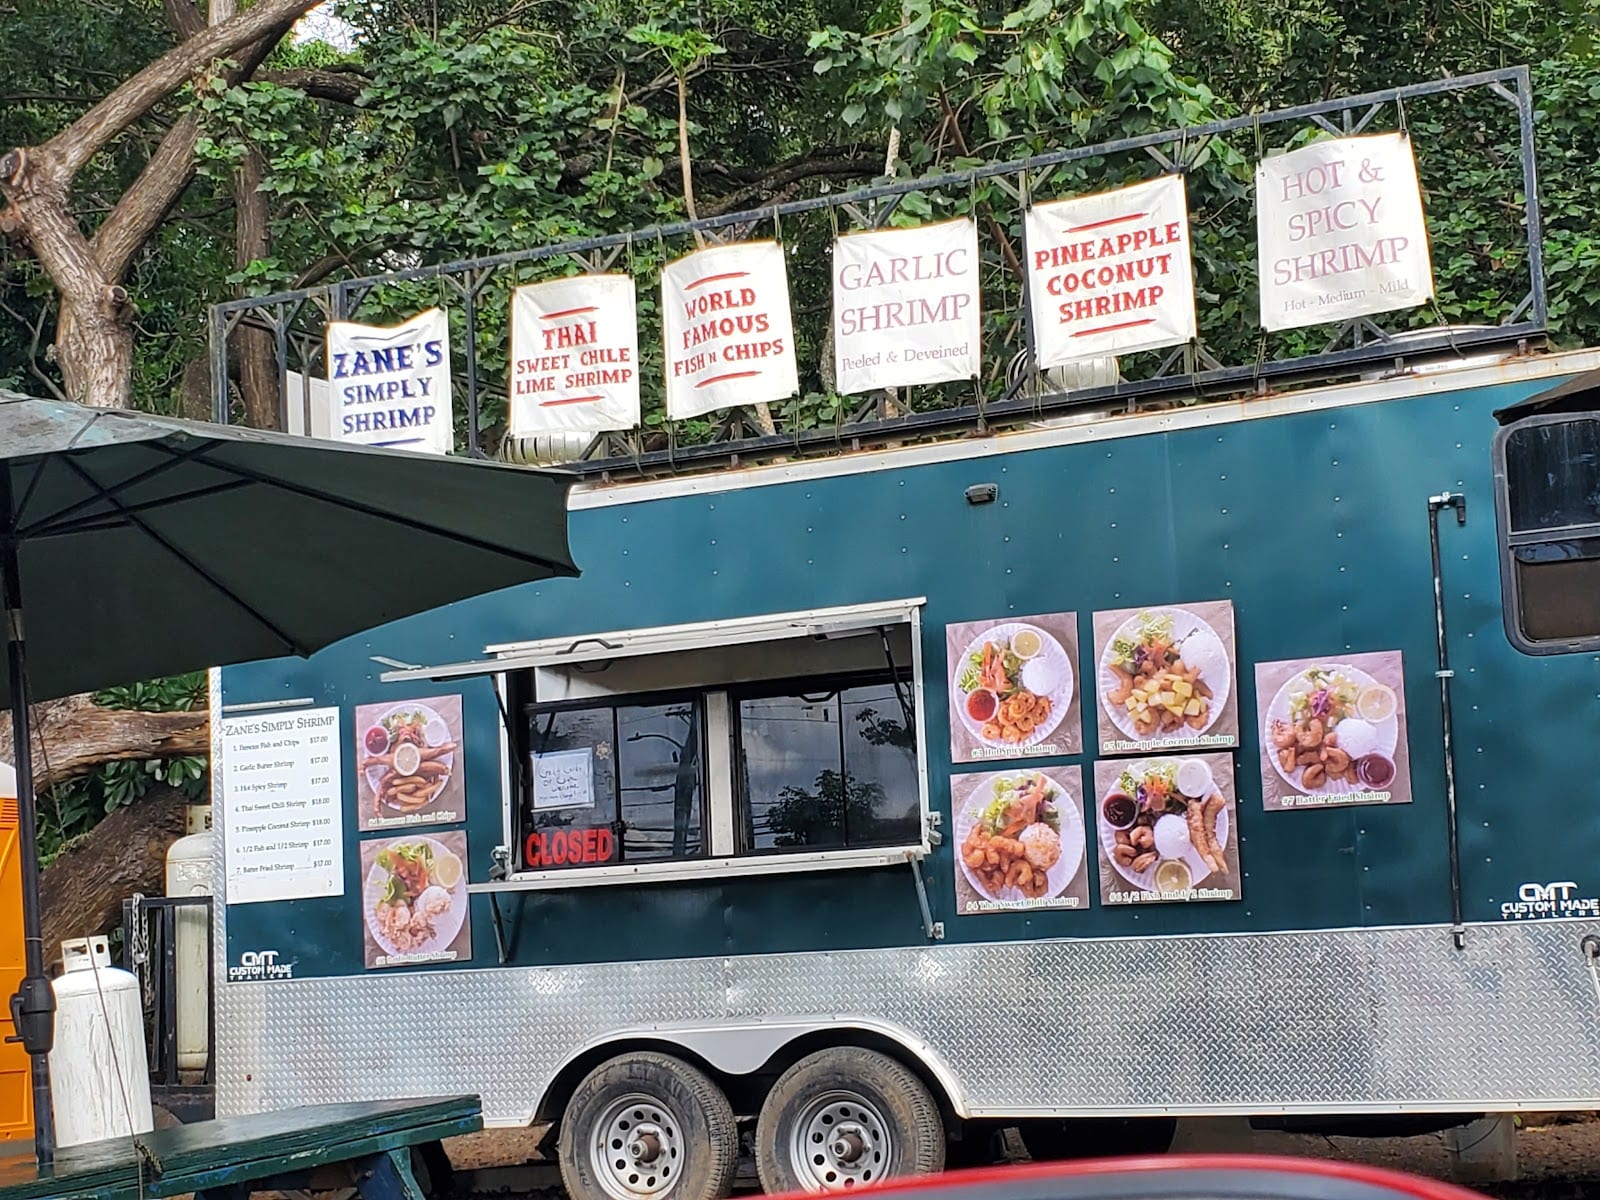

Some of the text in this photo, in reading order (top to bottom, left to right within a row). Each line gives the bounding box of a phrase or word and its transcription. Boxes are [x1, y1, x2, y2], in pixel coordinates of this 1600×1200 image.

[1281, 158, 1385, 202] HOT &
[1288, 196, 1382, 242] SPICY
[1034, 221, 1182, 270] PINEAPPLE
[1273, 236, 1409, 286] SHRIMP
[839, 248, 969, 290] GARLIC
[1046, 253, 1172, 296] COCONUT
[684, 288, 756, 321] WORLD
[1058, 285, 1164, 324] SHRIMP
[1284, 299, 1306, 311] Hot
[1318, 289, 1366, 306] Medium
[1379, 279, 1409, 295] Mild
[841, 293, 971, 336] SHRIMP
[542, 321, 597, 350] THAI
[682, 313, 770, 350] FAMOUS
[333, 339, 443, 379] ZANE'S
[516, 347, 631, 375] SWEET CHILE
[673, 338, 784, 377] FISH N CHIPS
[842, 342, 969, 371] Peeled & Deveined
[343, 376, 433, 407] SIMPLY
[516, 369, 632, 395] LIME SHRIMP
[342, 405, 436, 435] SHRIMP
[261, 720, 295, 733] SIMPLY
[297, 716, 335, 729] SHRIMP
[525, 828, 614, 867] CLOSED
[1122, 890, 1140, 904] 1/2
[1501, 898, 1600, 913] CUSTOM MADE
[1502, 909, 1600, 919] TRAILERS
[230, 964, 292, 975] CUSTOM MADE
